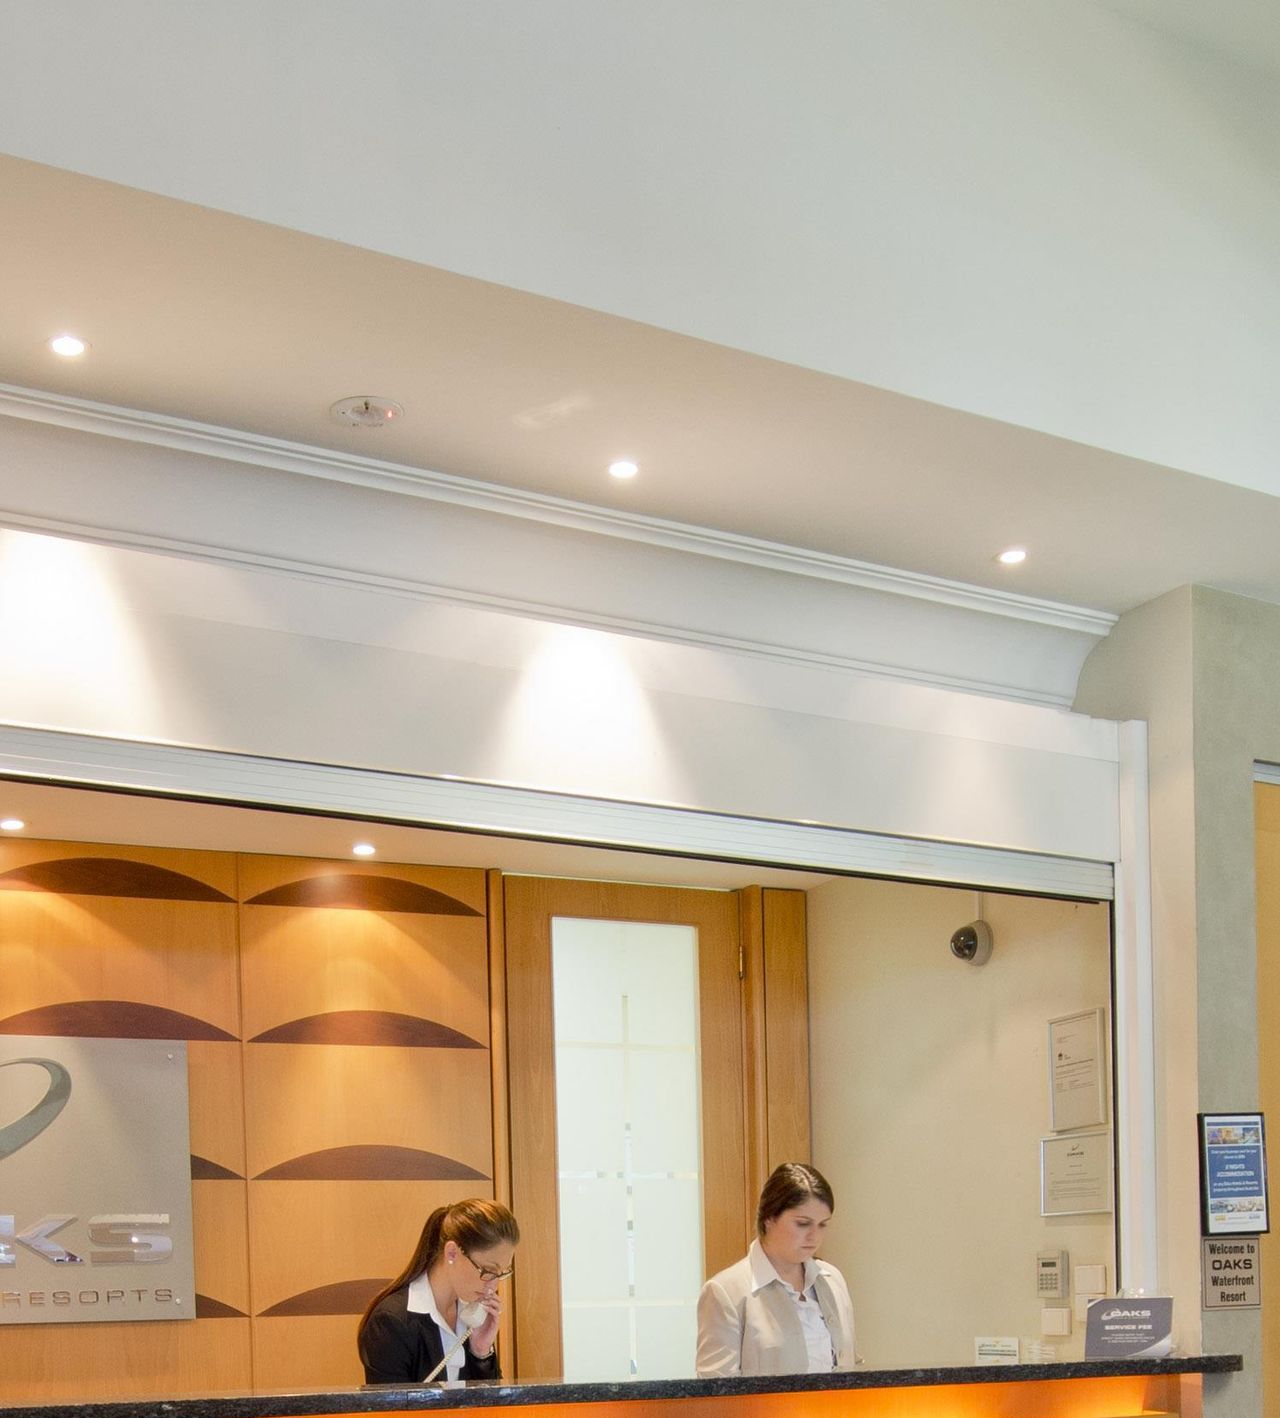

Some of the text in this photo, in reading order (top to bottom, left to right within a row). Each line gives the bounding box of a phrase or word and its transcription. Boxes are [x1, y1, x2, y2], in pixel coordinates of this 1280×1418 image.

[1209, 1243, 1256, 1254] Welcome to
[1212, 1259, 1253, 1270] OAKS
[1211, 1275, 1254, 1286] Waterfront
[1, 1288, 173, 1309] RESORTS
[1220, 1291, 1246, 1302] Resort
[1110, 1309, 1152, 1317] OAKS
